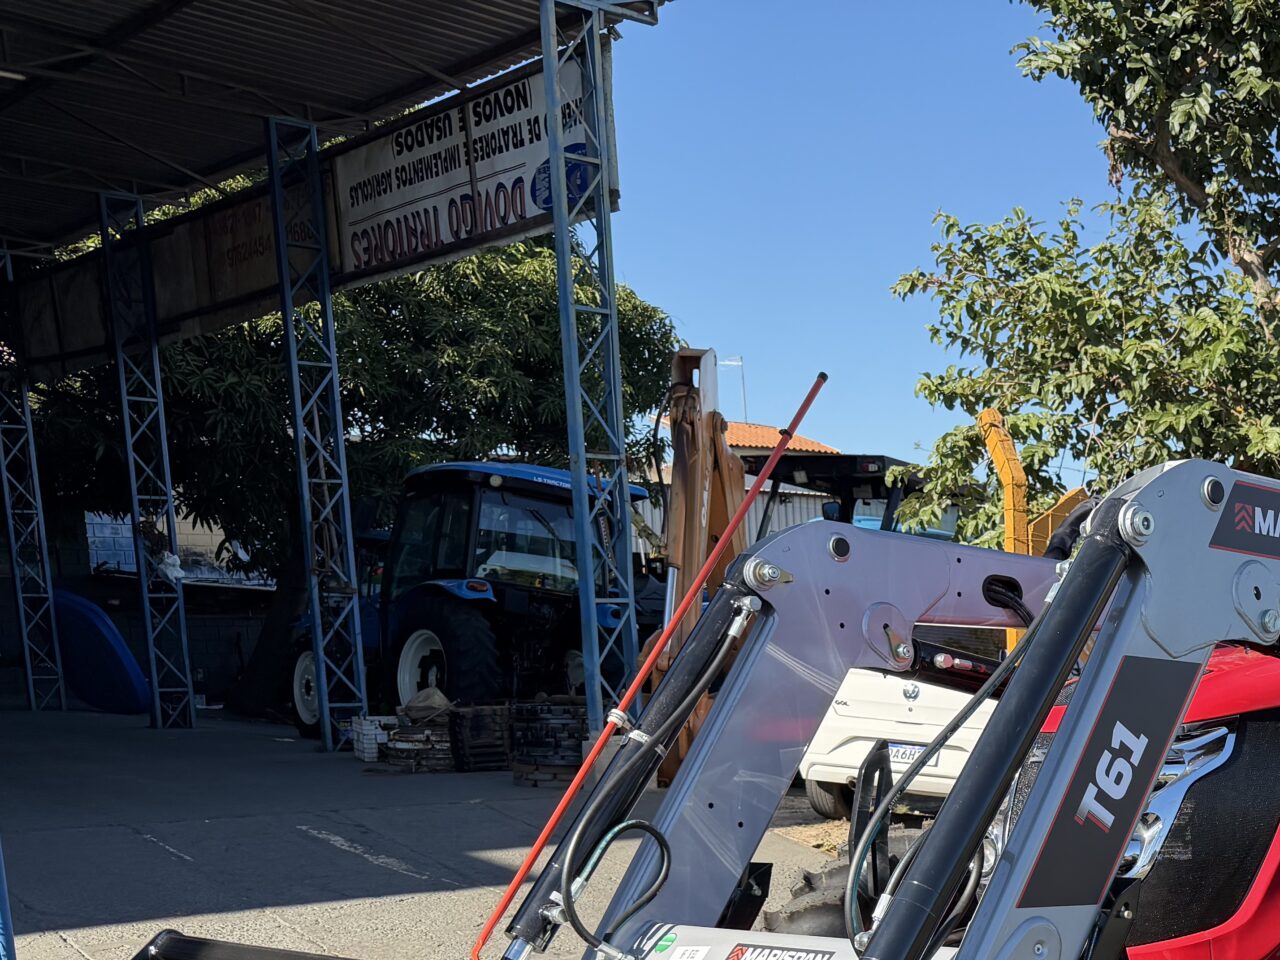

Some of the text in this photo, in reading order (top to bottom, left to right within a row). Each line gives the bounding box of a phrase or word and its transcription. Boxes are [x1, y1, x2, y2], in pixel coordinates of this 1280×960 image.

[473, 121, 525, 163] TRATORES
[526, 113, 541, 145] DE
[395, 142, 462, 190] IMPLEMENTOS
[351, 204, 444, 270] TRATORES
[1074, 720, 1149, 834] T61
